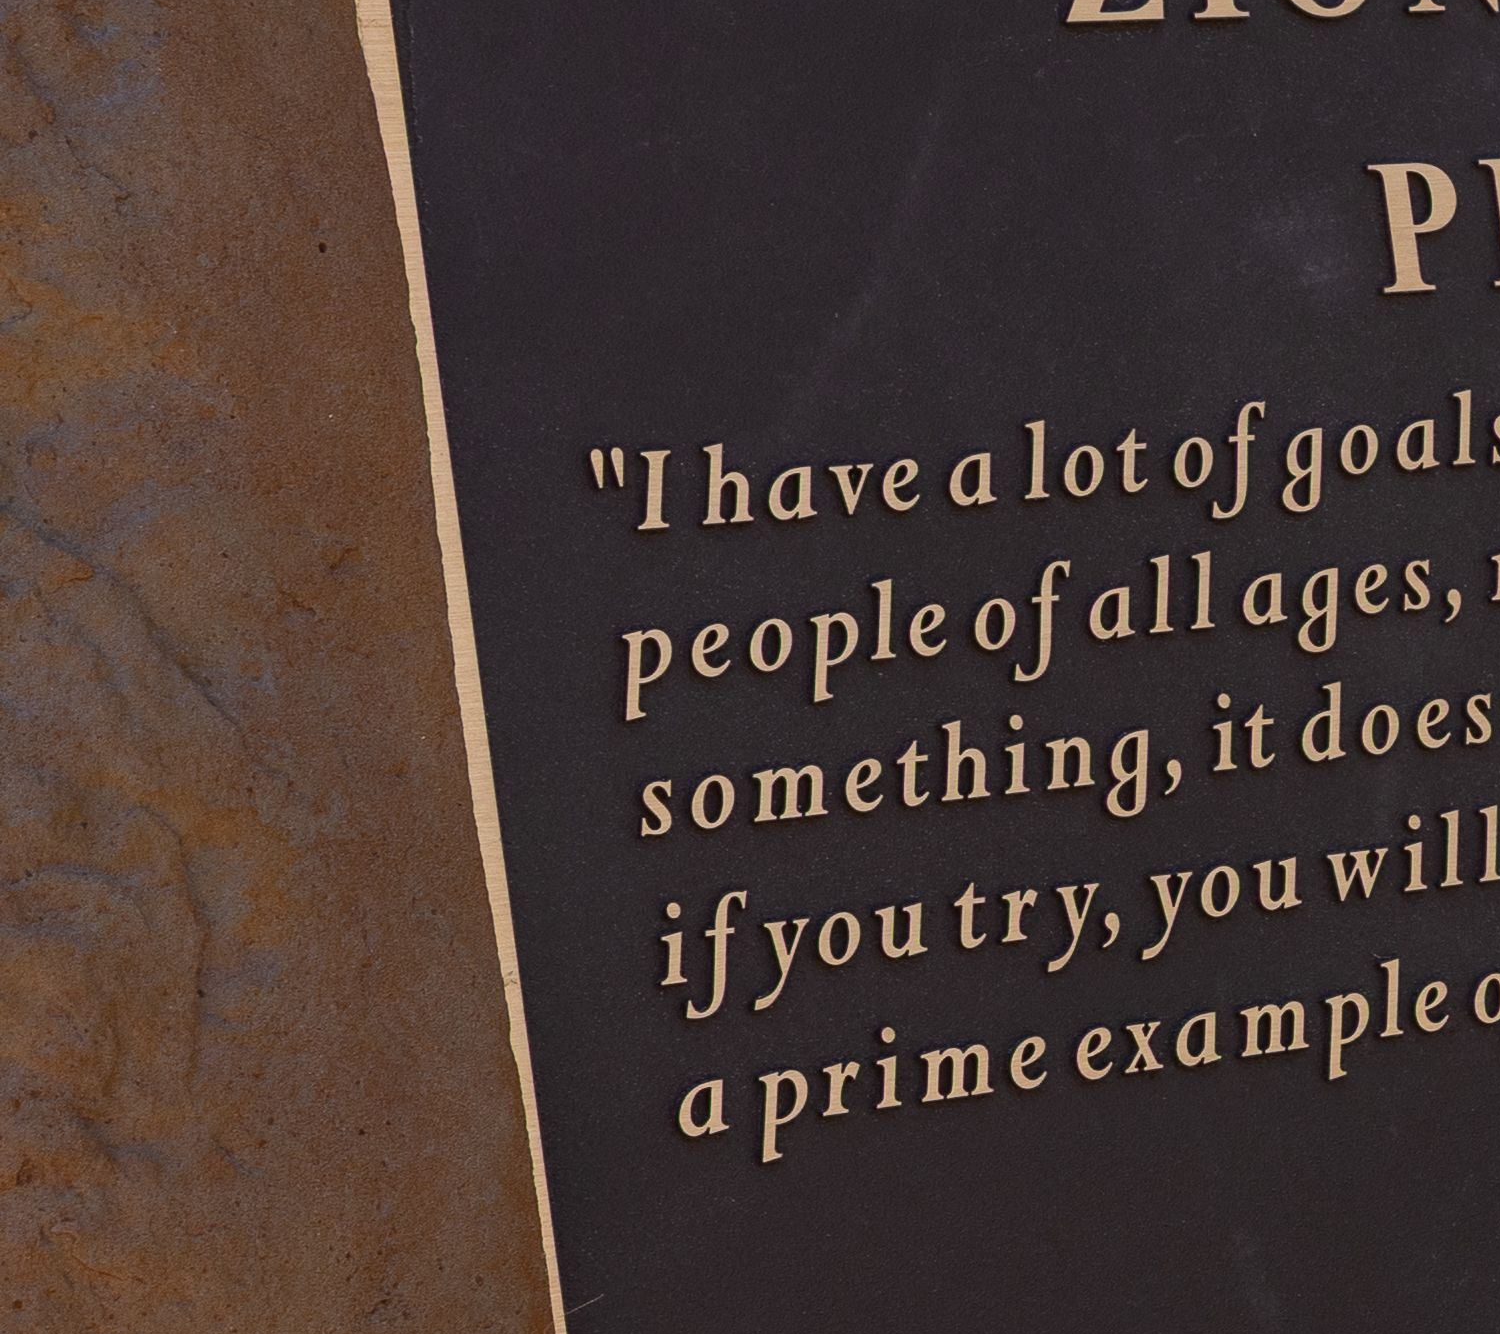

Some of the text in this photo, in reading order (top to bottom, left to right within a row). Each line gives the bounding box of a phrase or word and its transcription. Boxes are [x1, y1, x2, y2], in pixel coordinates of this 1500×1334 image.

[588, 445, 674, 532] "I
[700, 440, 923, 527] have
[947, 450, 1000, 509] a
[1022, 417, 1151, 502] lot
[1171, 398, 1268, 521] of
[619, 576, 949, 723] people
[972, 557, 1073, 684] of
[1087, 548, 1218, 642] all
[1240, 557, 1464, 655] ages,
[638, 712, 1184, 839] something,
[1210, 690, 1278, 774] it
[658, 888, 750, 1022] if
[752, 900, 931, 1013] you
[951, 880, 1123, 975] try,
[1139, 854, 1305, 963] you
[676, 1076, 732, 1139] a
[756, 1024, 1050, 1165] prime
[1074, 956, 1452, 1083] example
